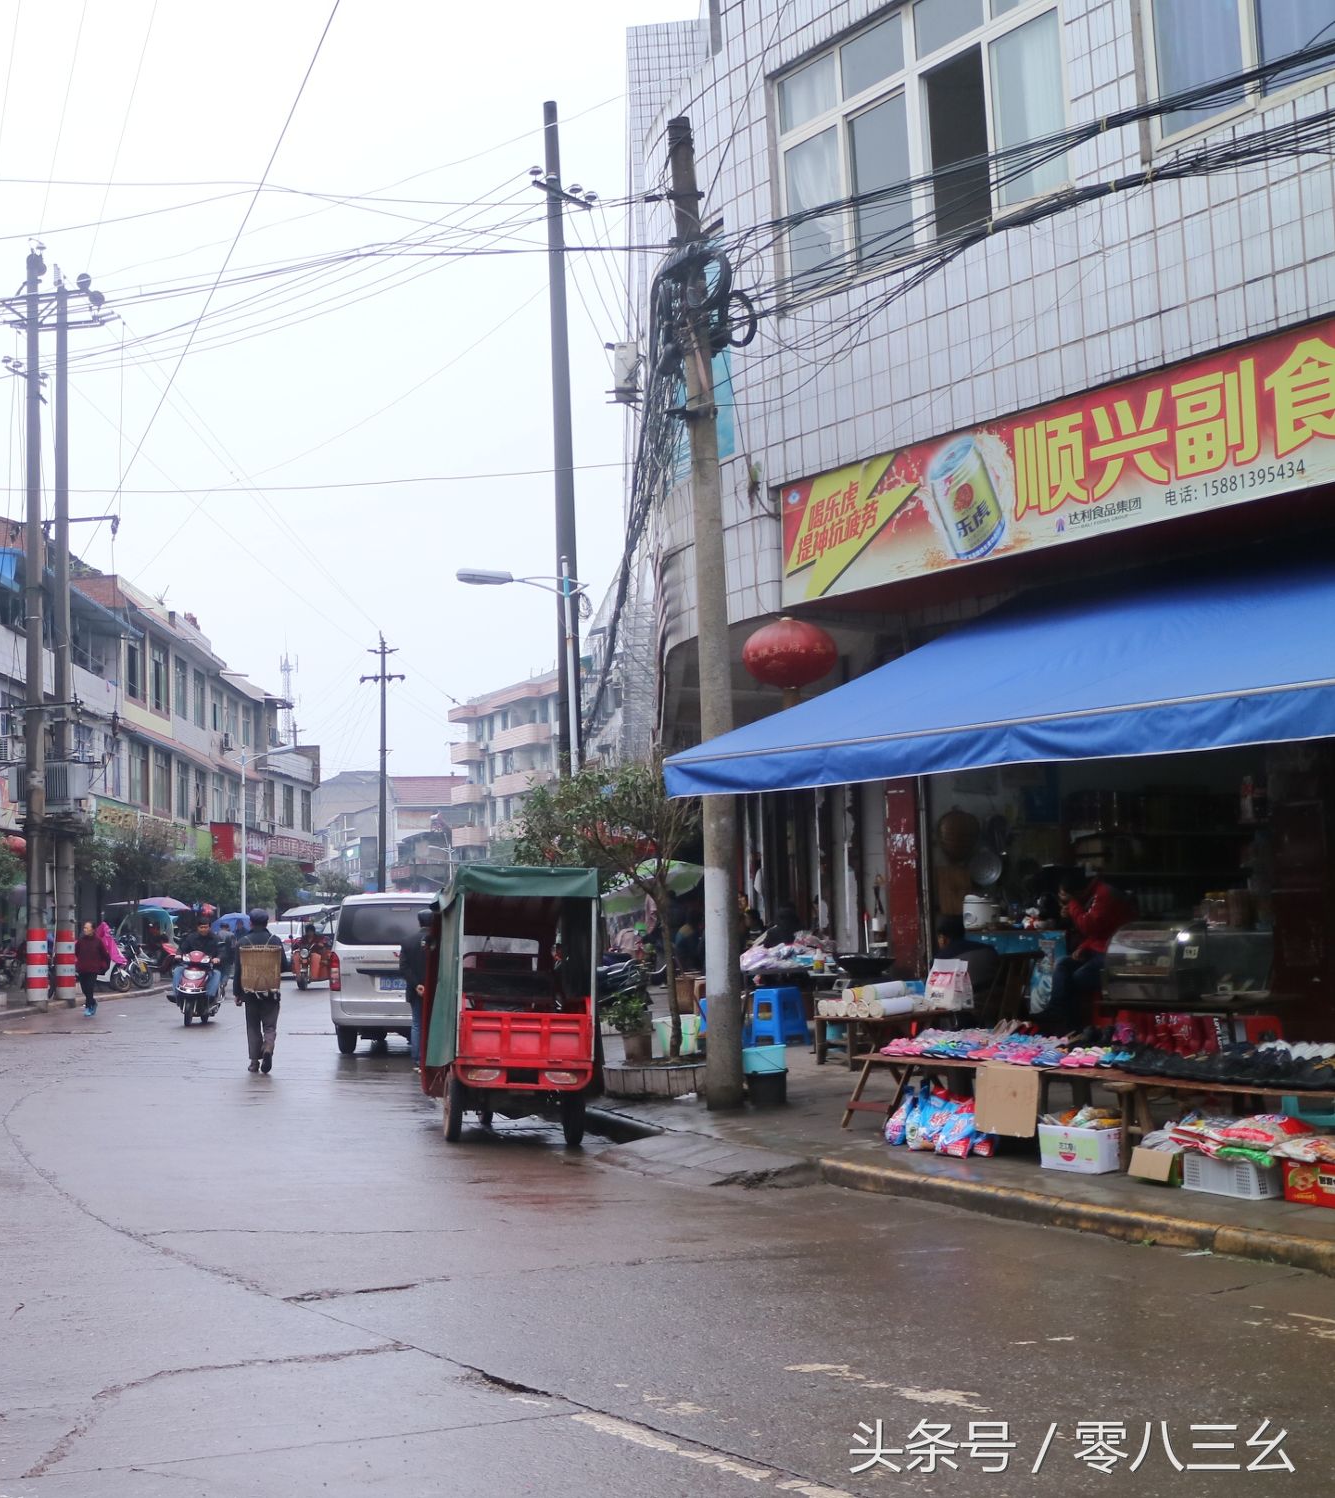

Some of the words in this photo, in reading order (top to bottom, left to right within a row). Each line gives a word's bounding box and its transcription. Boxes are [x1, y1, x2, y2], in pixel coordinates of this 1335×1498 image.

[1014, 336, 1335, 523] 顺兴副食
[1202, 459, 1305, 498] 15881395434
[796, 500, 879, 564] 提神抗疲劳
[808, 480, 859, 532] 喝乐虎
[1068, 497, 1142, 526] 达利食品集团
